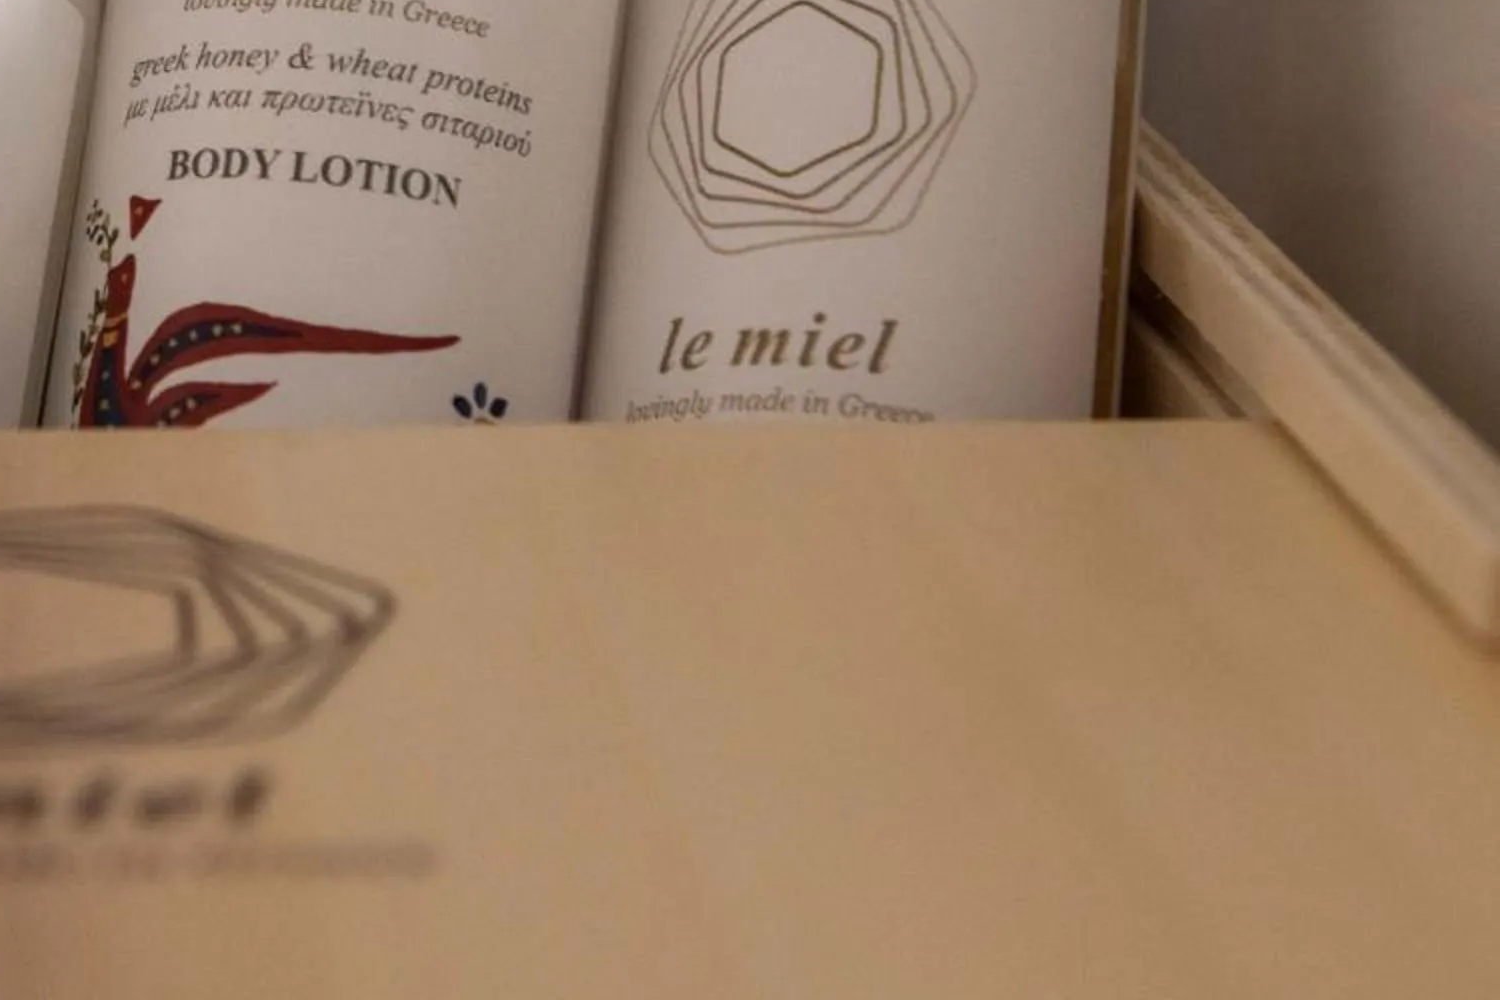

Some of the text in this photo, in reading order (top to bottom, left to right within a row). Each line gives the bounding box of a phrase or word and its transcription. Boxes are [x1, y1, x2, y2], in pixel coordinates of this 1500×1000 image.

[402, 0, 490, 38] Greece
[129, 41, 533, 116] greek honey & wheat proteins
[123, 98, 149, 128] με
[150, 82, 201, 121] μέλι
[208, 89, 252, 109] και
[421, 111, 532, 158] σιταριού
[166, 147, 463, 210] BODY LOTION
[658, 311, 899, 375] le miel
[718, 386, 797, 413] made
[803, 389, 829, 417] in
